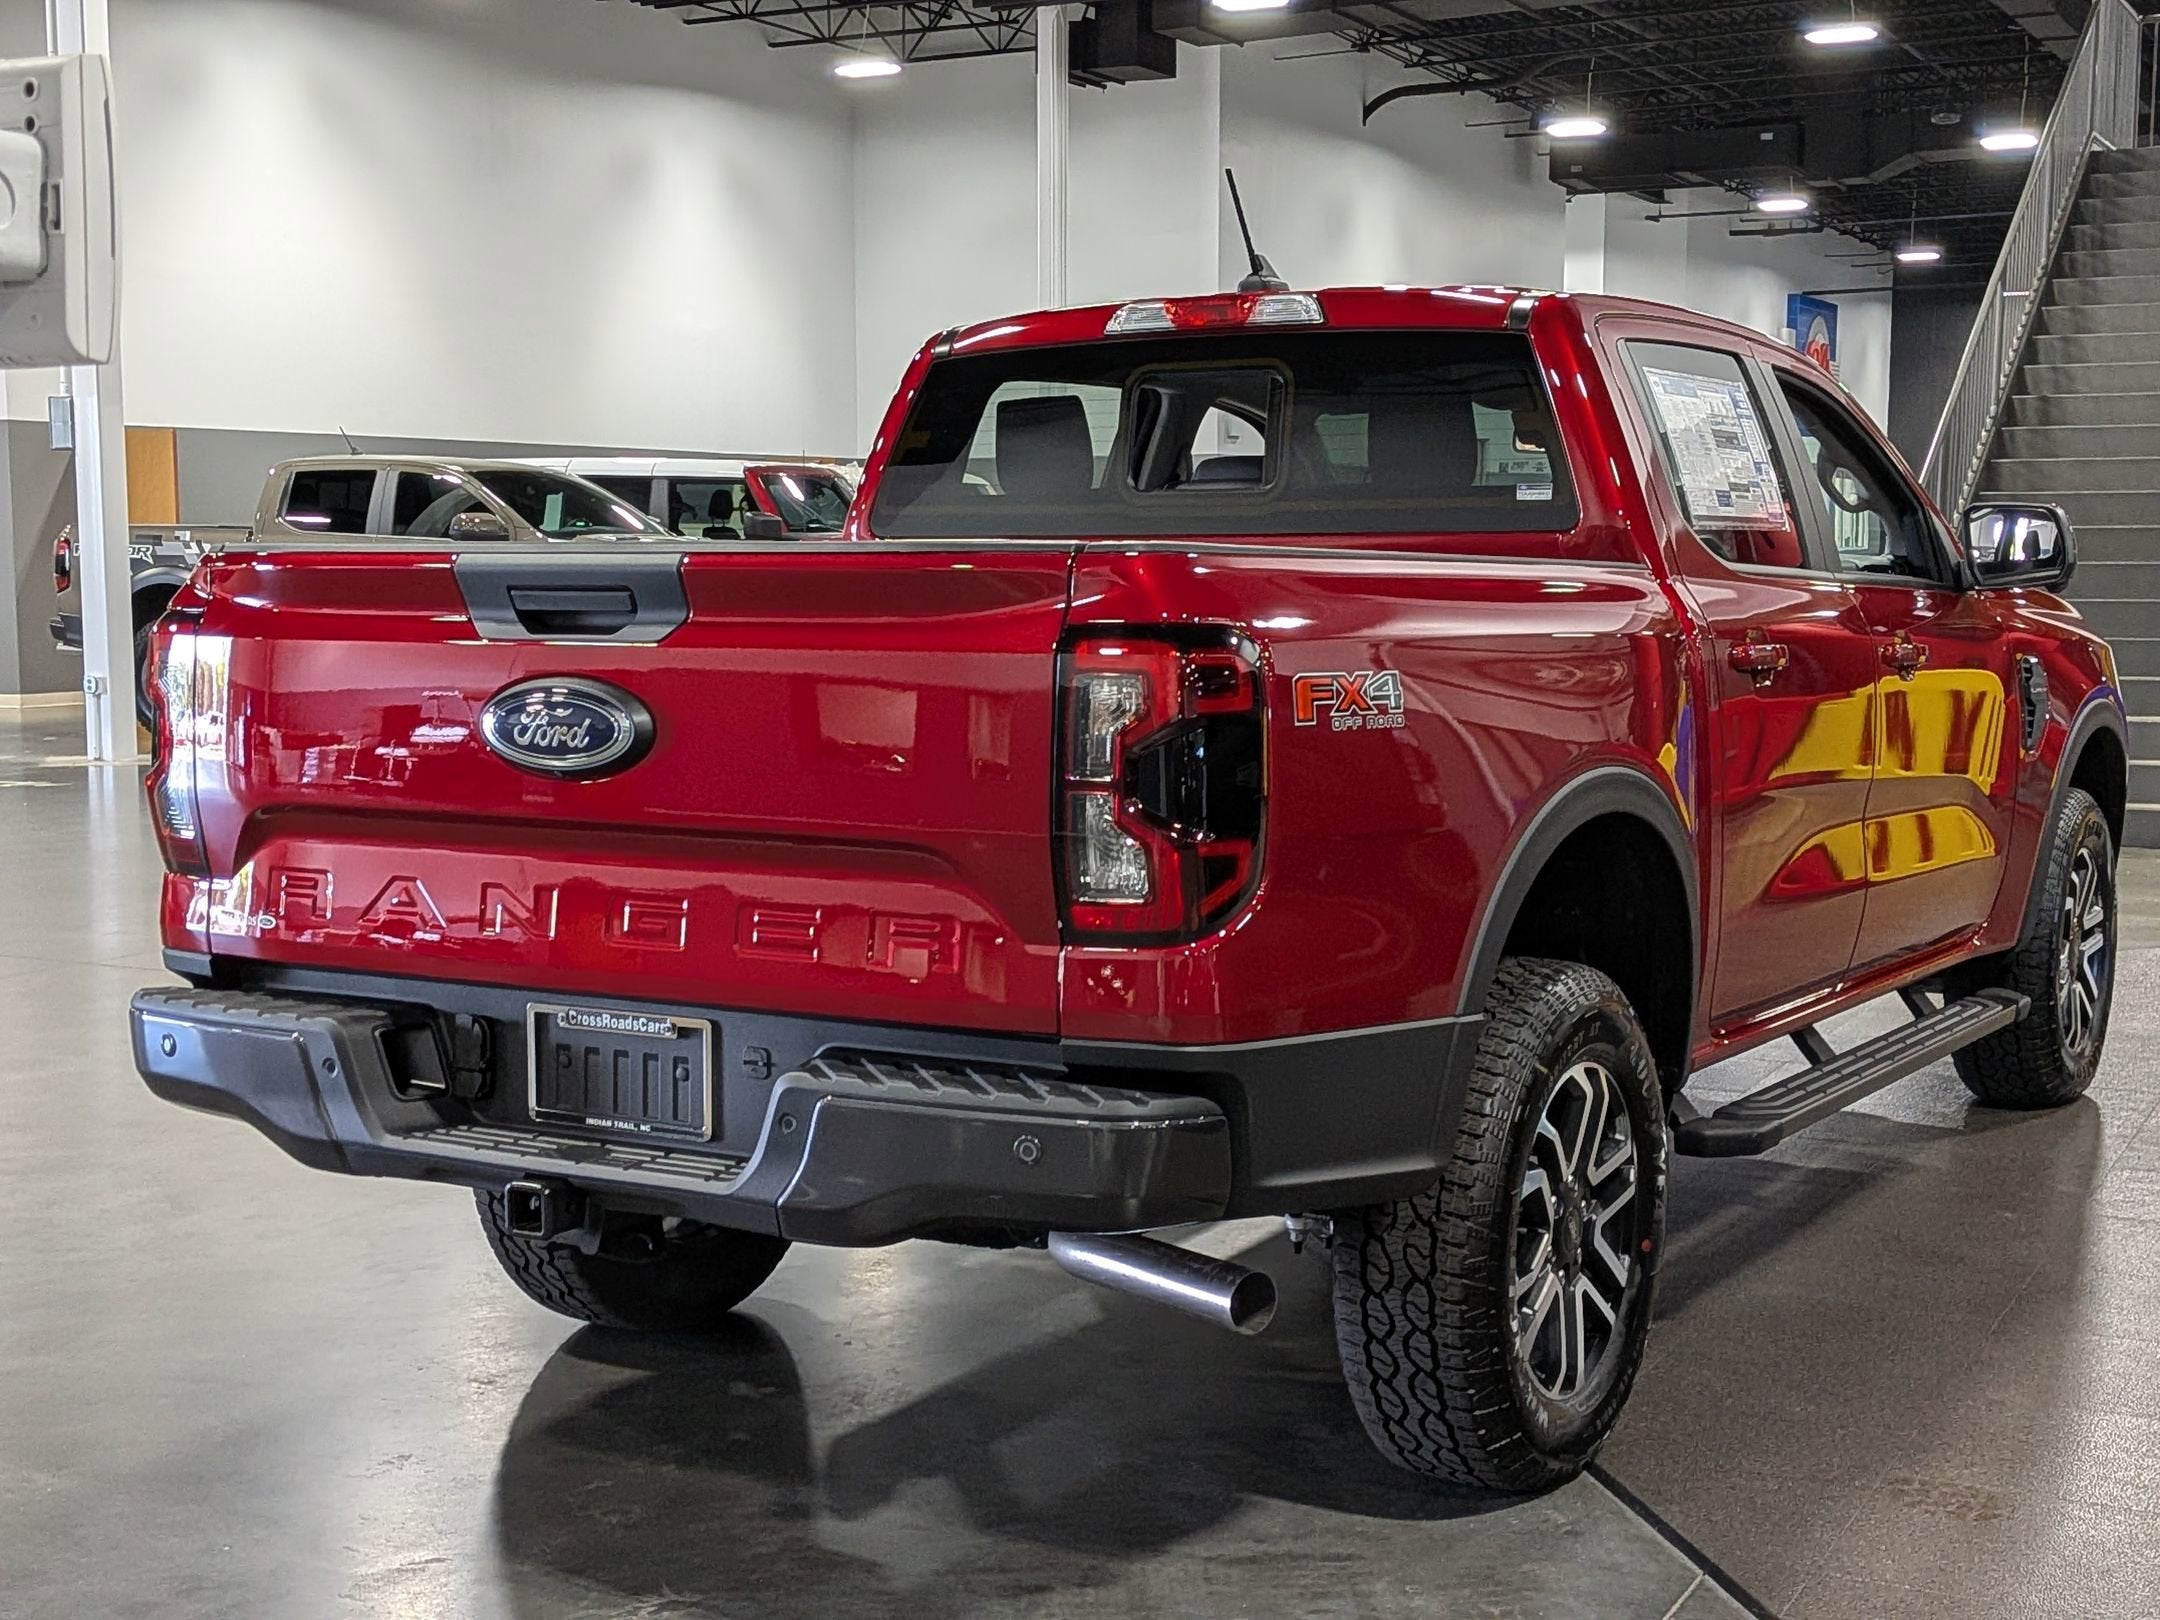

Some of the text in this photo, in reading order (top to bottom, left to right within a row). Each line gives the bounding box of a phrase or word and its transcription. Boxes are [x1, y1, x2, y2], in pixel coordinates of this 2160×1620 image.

[1292, 670, 1404, 726] FX4
[514, 706, 592, 748] Ford
[1332, 714, 1405, 731] OFF ROAD
[266, 866, 962, 975] RANGER
[585, 1117, 612, 1127] INDIAN
[640, 1124, 651, 1132] NC
